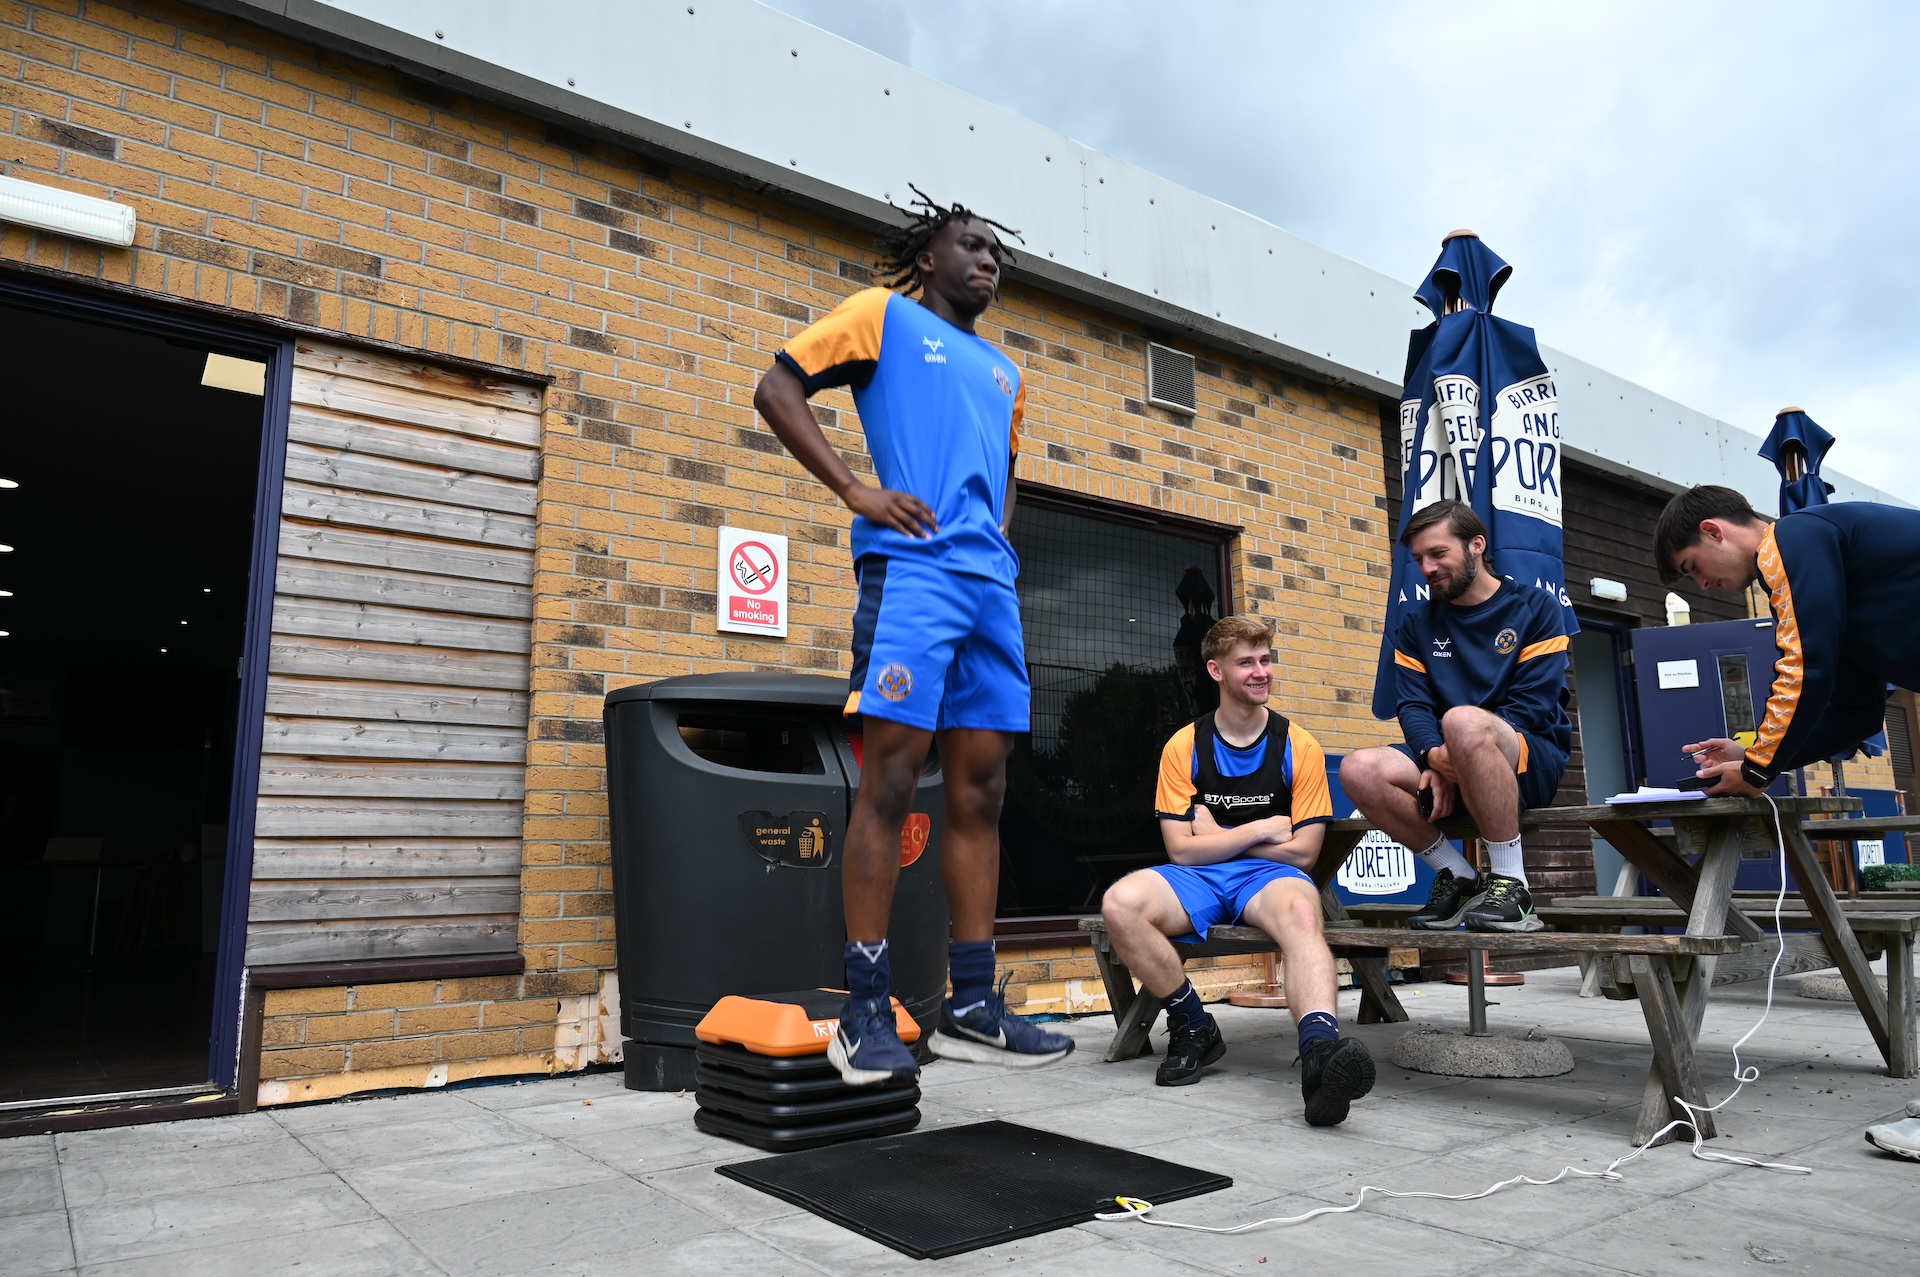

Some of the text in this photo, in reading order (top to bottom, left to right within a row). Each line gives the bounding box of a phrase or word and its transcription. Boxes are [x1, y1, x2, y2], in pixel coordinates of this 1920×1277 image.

[1438, 383, 1481, 408] IFICI
[1515, 494, 1549, 512] BIRRA
[747, 599, 761, 610] No
[733, 609, 775, 624] smoking
[755, 826, 791, 837] general
[760, 837, 787, 846] waste
